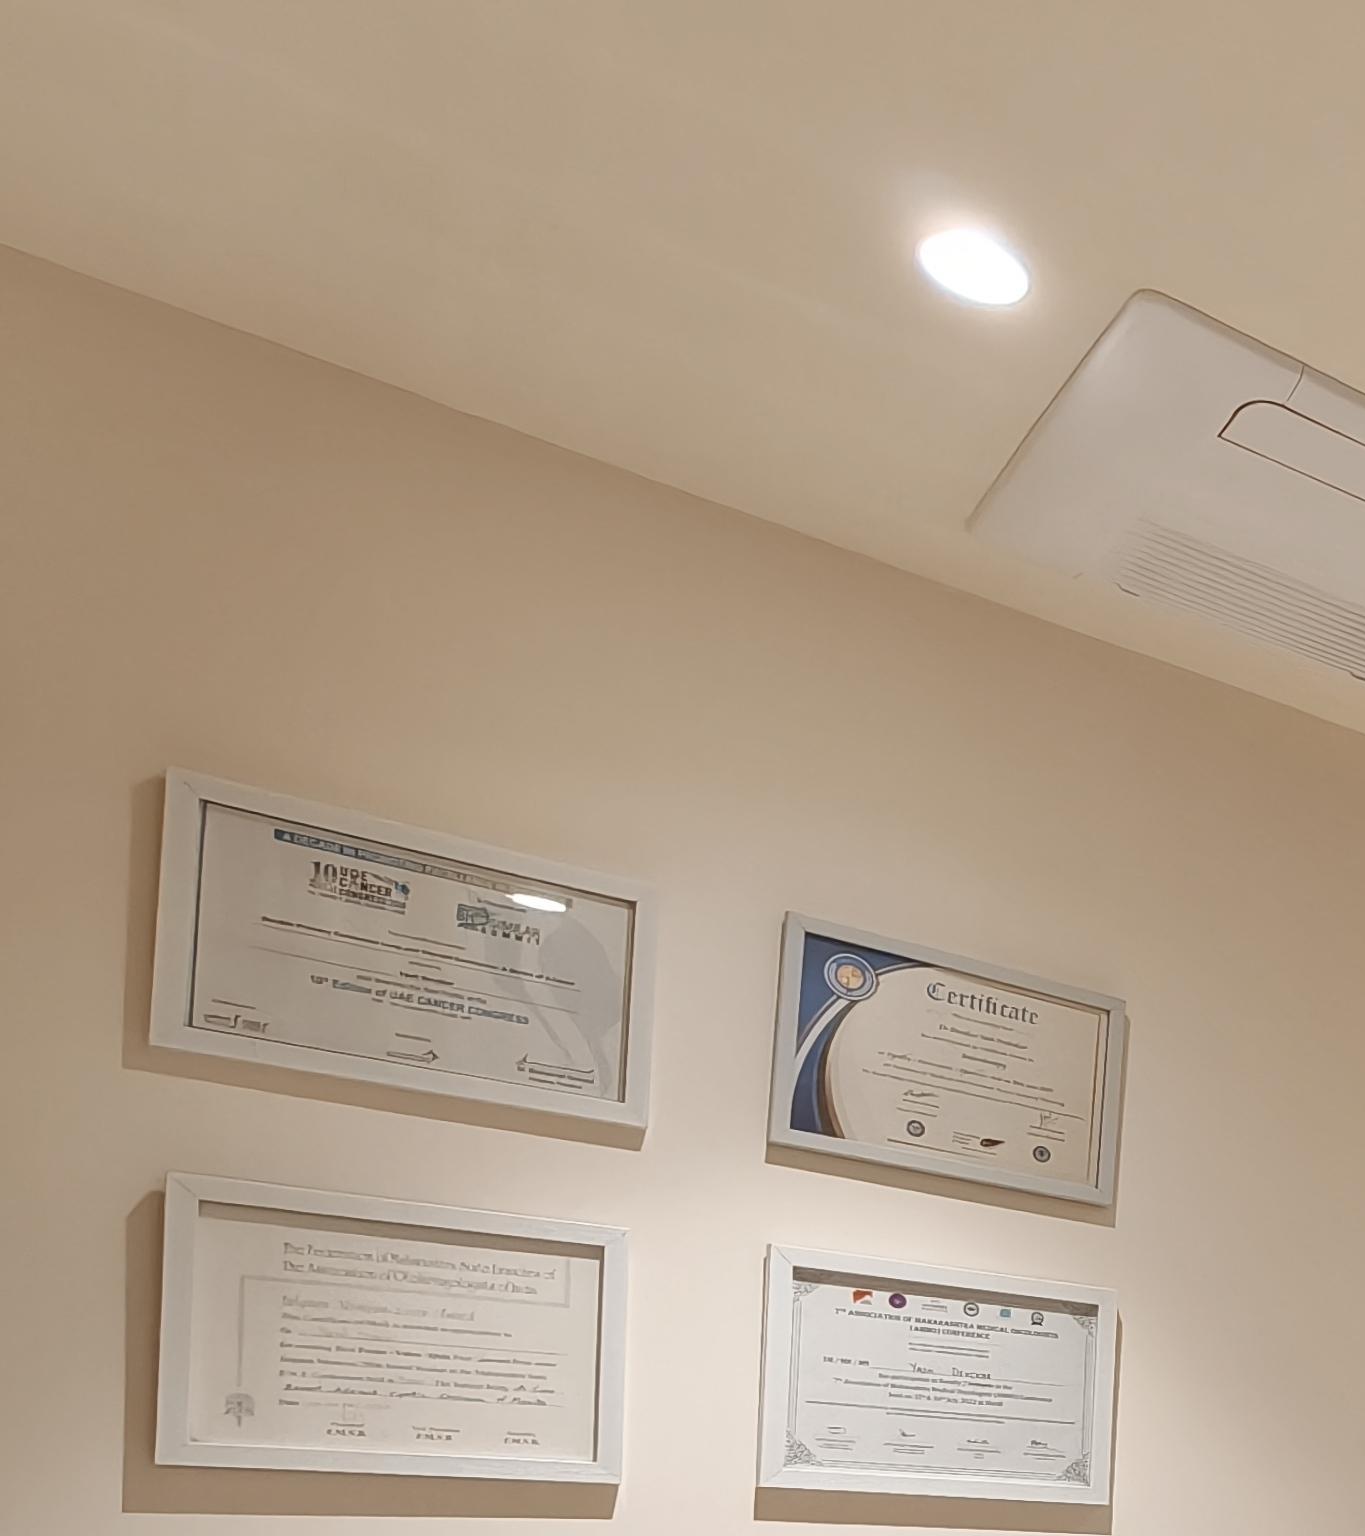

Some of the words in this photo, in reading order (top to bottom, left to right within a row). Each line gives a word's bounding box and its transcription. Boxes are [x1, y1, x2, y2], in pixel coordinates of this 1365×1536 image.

[339, 877, 392, 897] CANCER
[417, 995, 465, 1014] CANCER
[926, 981, 1040, 1026] Certificate
